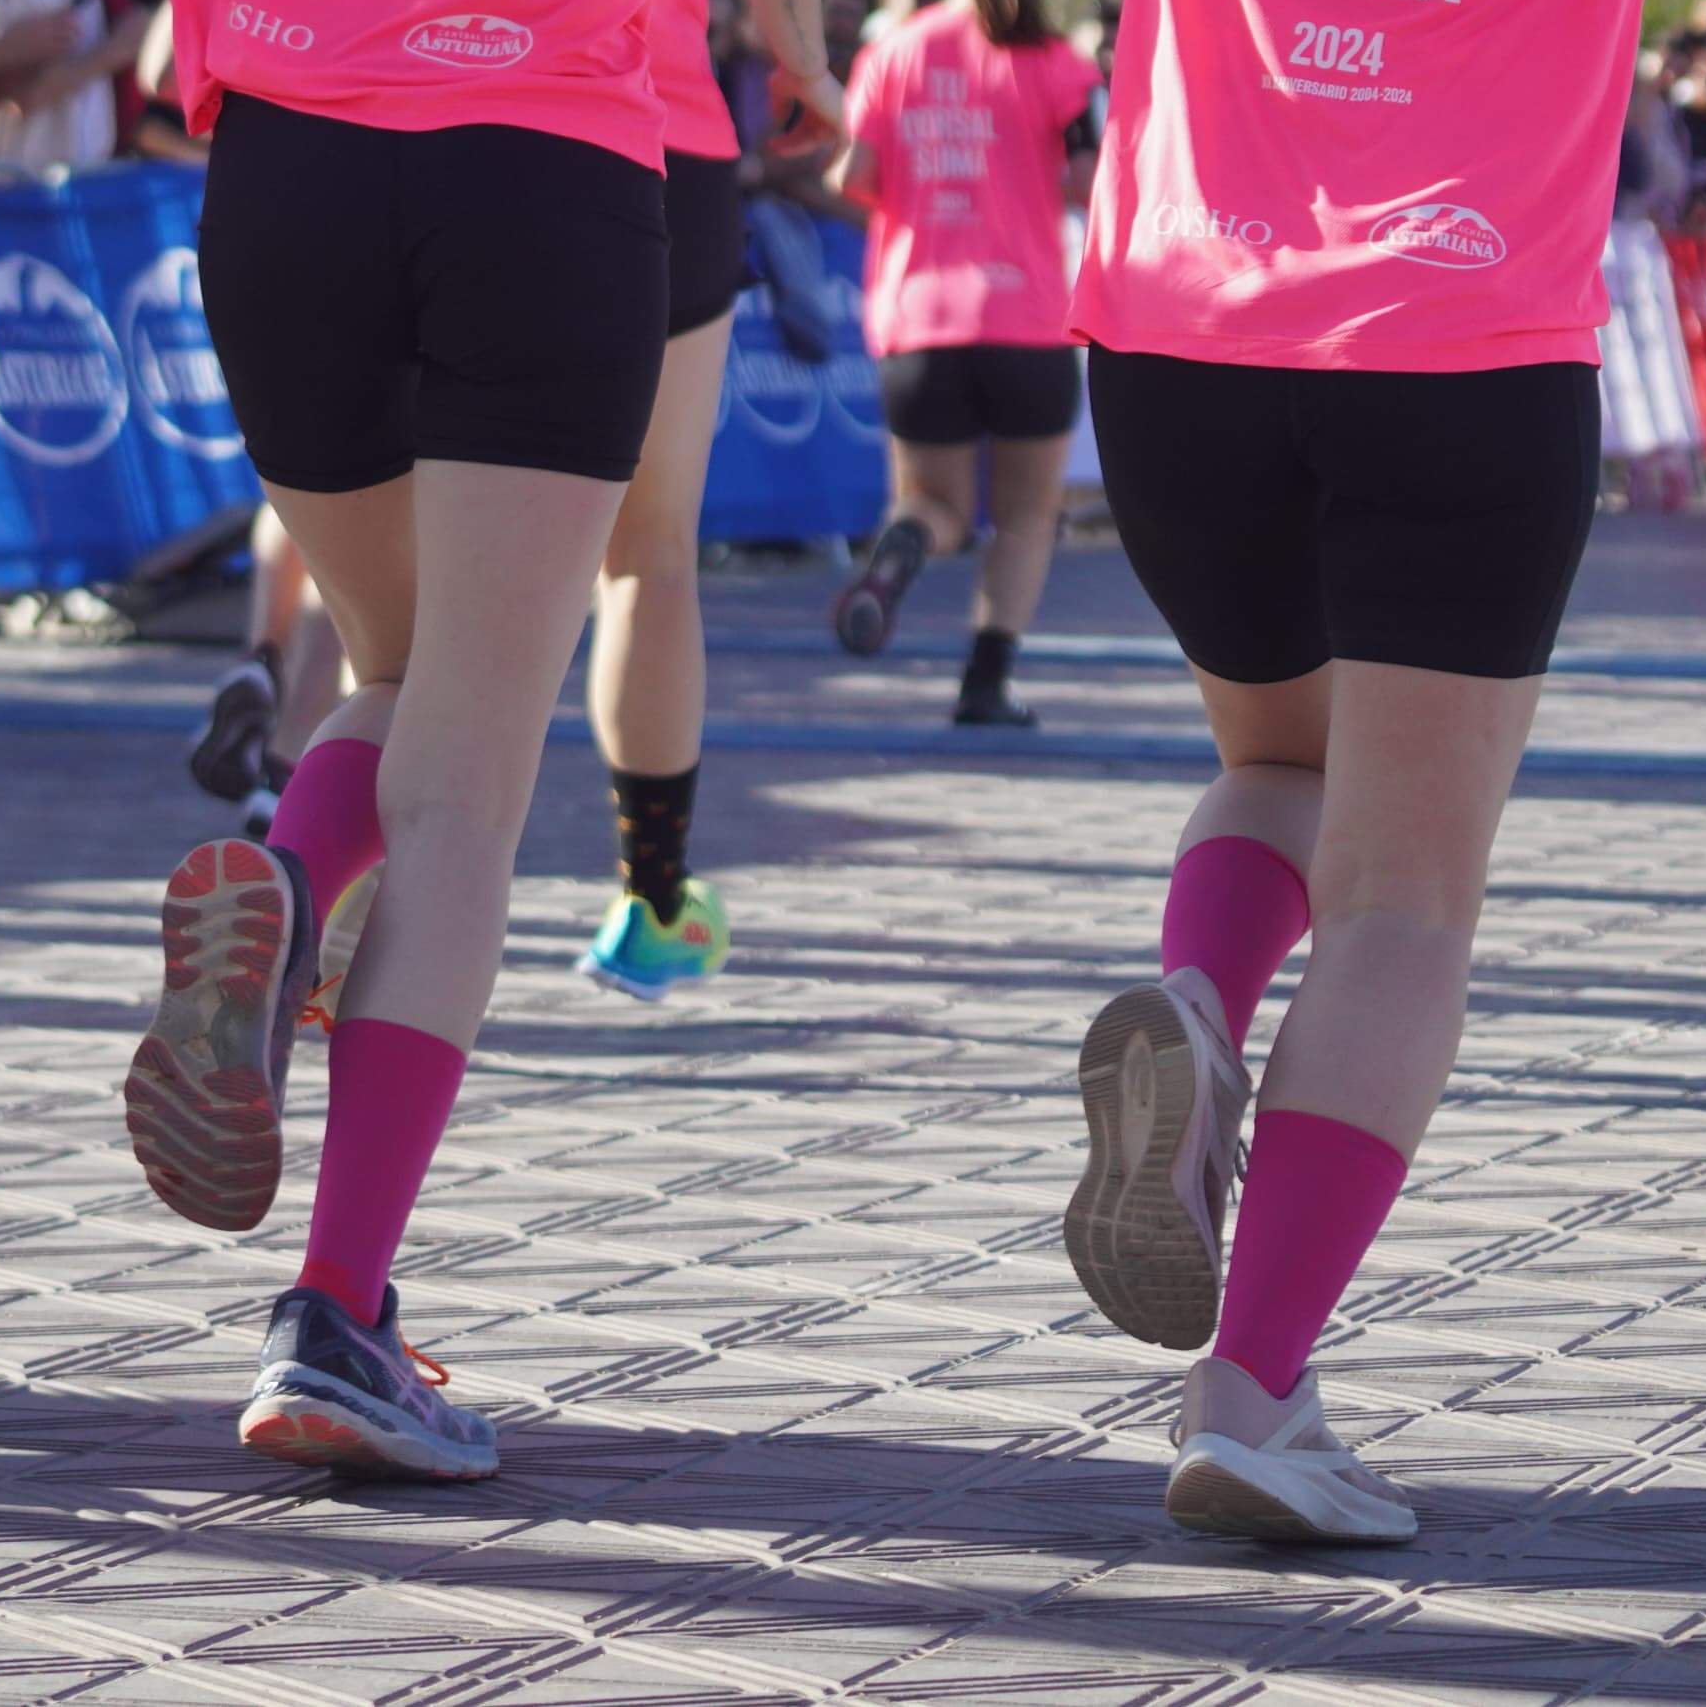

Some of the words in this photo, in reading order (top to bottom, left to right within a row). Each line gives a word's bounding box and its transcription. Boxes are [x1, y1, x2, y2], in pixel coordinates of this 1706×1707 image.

[229, 3, 315, 51] SHO
[413, 29, 523, 57] ASTURIANA
[1289, 21, 1386, 77] 2024
[1382, 223, 1496, 259] ASTURIANA
